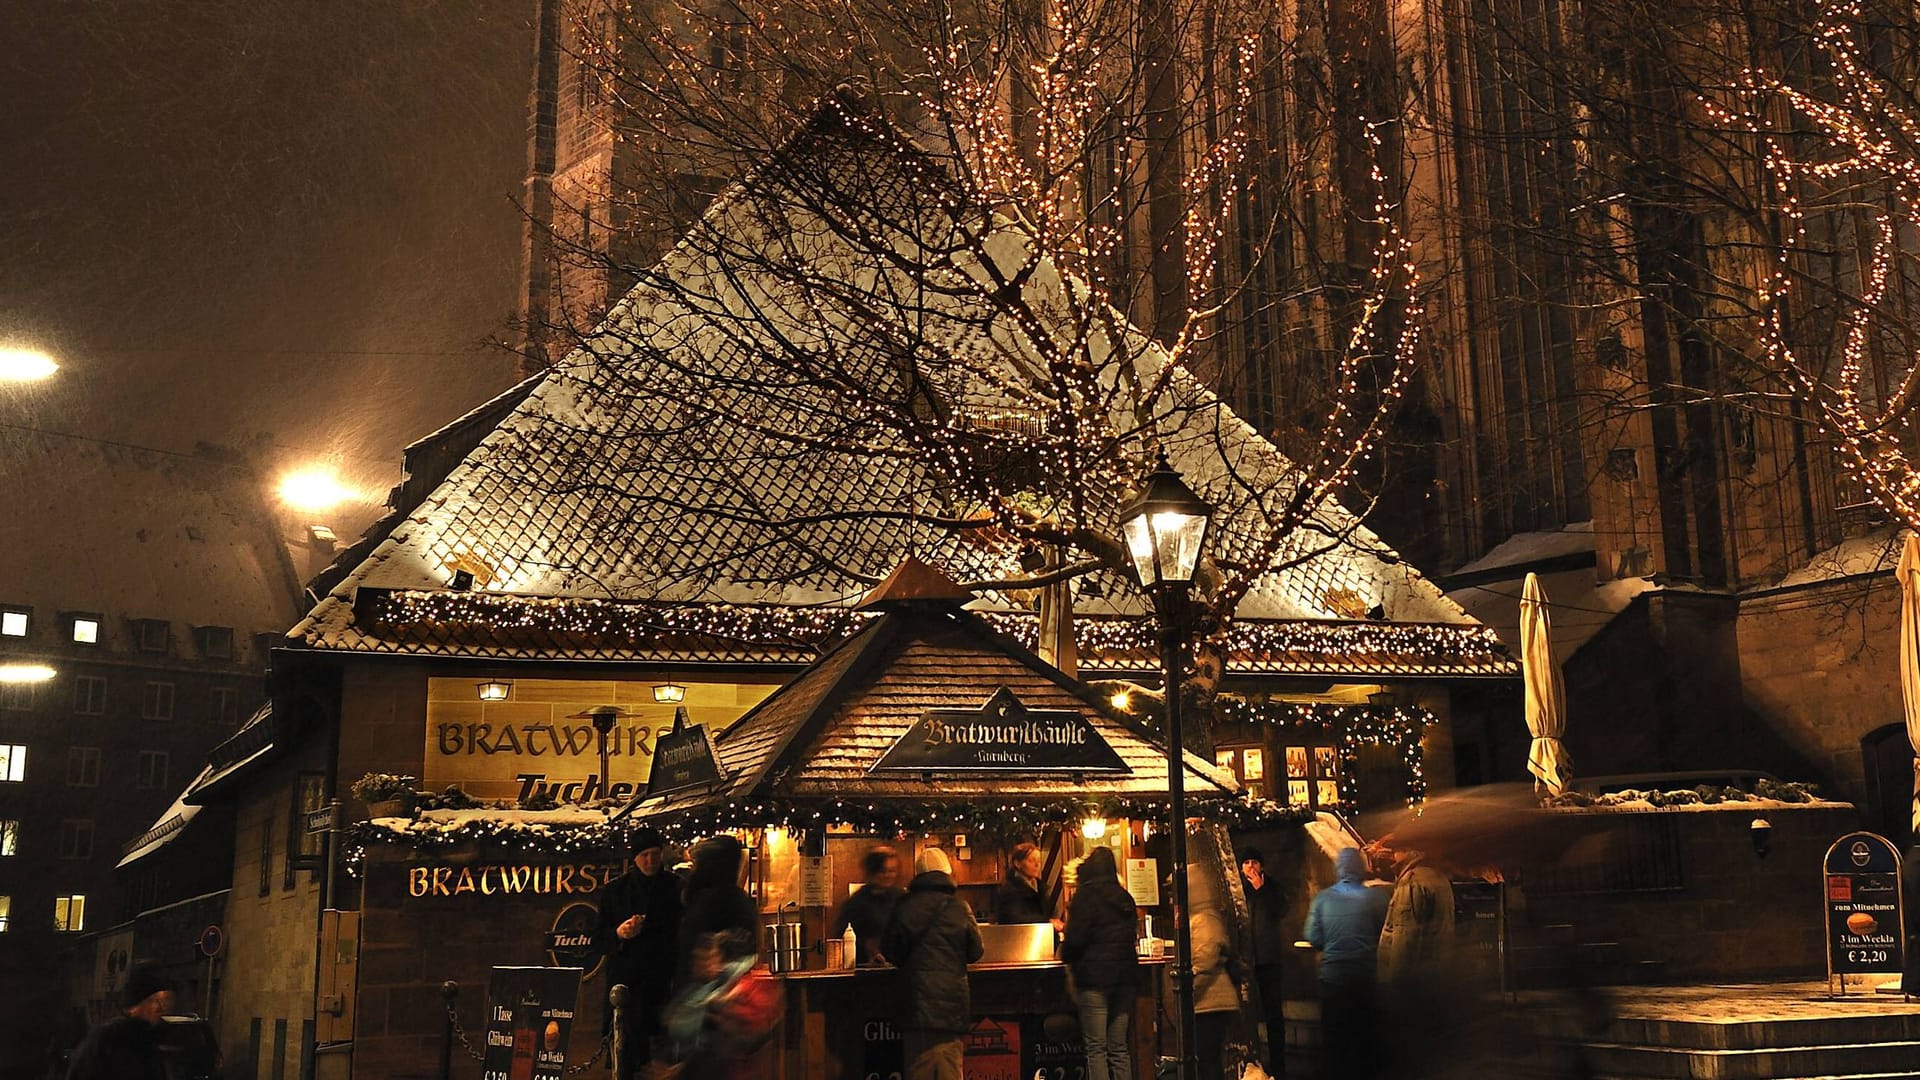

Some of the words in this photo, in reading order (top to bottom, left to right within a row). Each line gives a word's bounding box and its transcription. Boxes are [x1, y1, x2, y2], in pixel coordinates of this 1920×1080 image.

[1840, 935, 1845, 944] 3
[1846, 934, 1860, 944] im
[1848, 950, 1857, 962] €
[1859, 950, 1887, 964] 2,20
